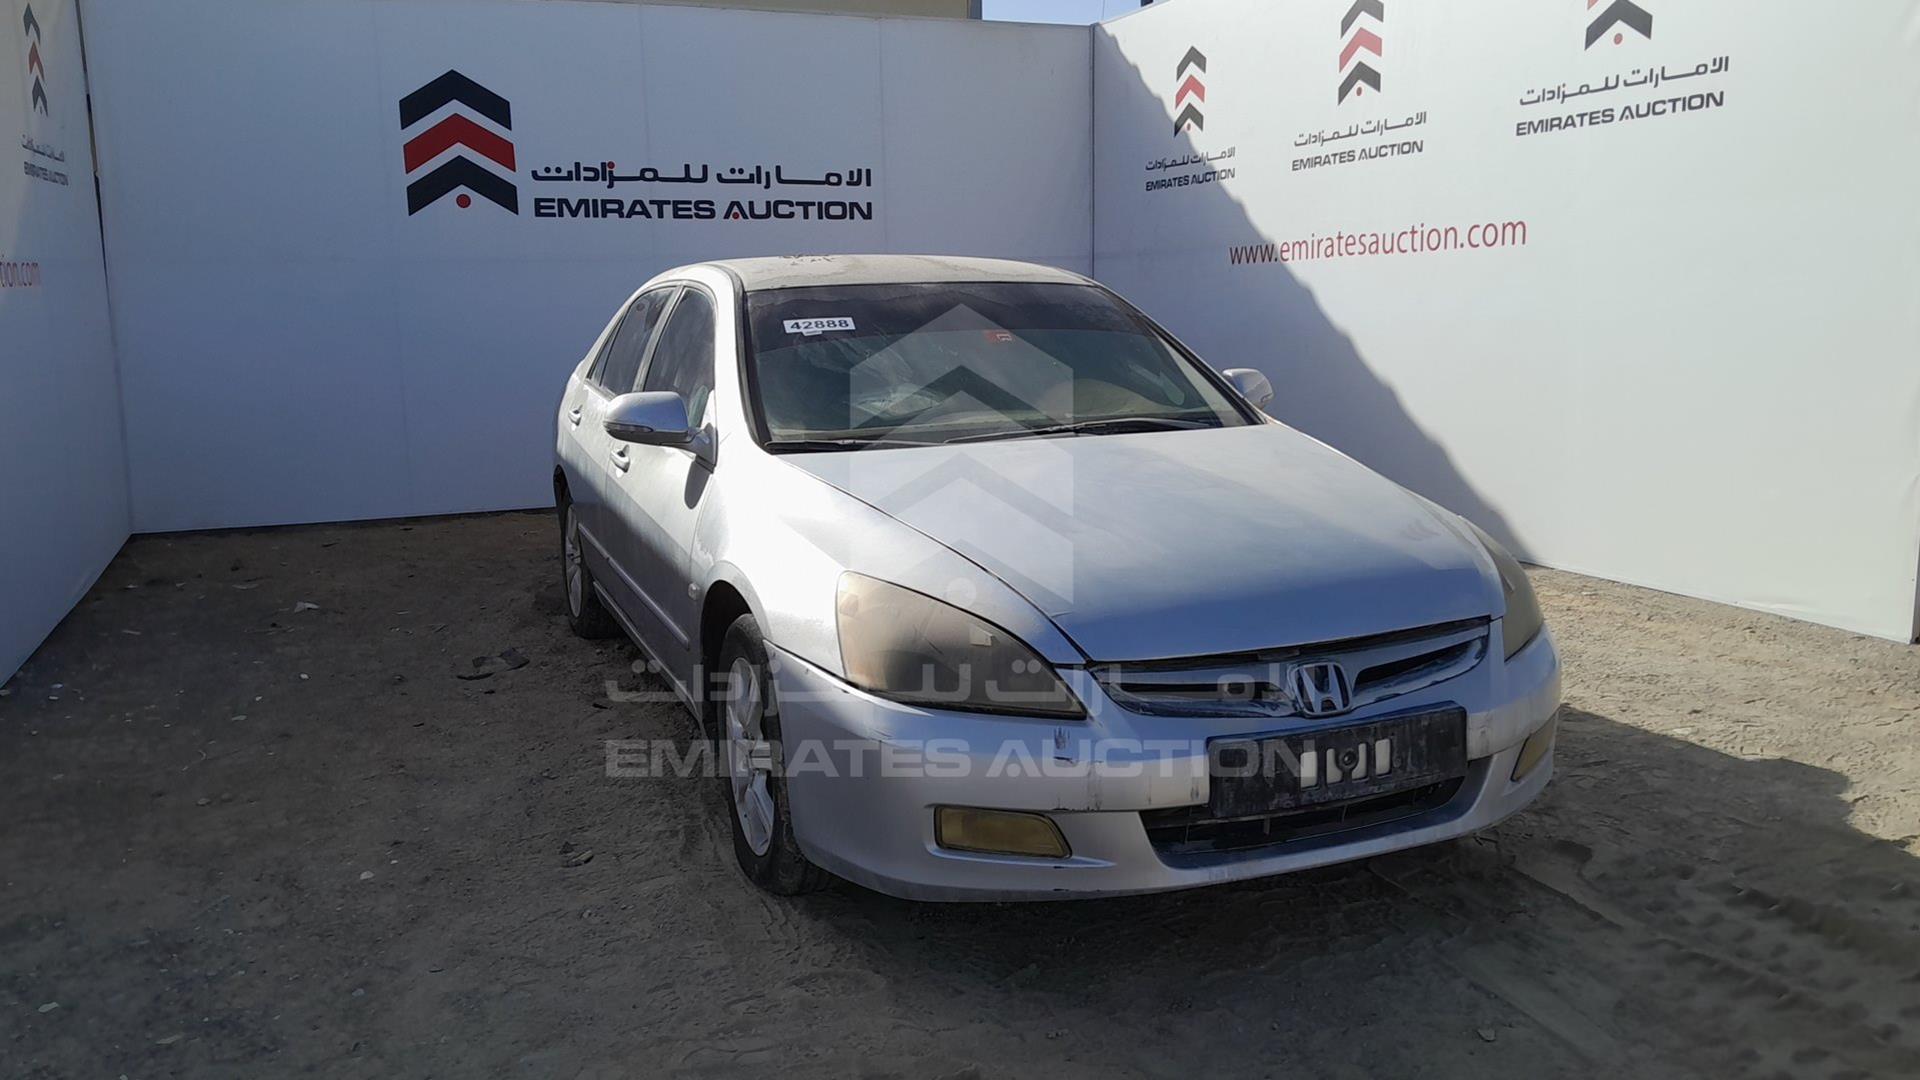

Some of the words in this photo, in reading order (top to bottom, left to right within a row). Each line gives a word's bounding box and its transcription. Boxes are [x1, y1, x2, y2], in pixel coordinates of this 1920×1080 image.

[1623, 56, 1730, 88] الامارات
[1519, 74, 1620, 106] للمزادات
[1515, 108, 1615, 137] EMIRATES
[1618, 90, 1725, 122] AUCTION
[1294, 126, 1359, 148] للمزادات
[1291, 149, 1356, 172] EMIRATES
[1357, 140, 1424, 162] AUCTION
[531, 160, 708, 189] للمزادات
[716, 165, 873, 190] الامارات
[1145, 175, 1190, 192] EMIRATES
[1190, 168, 1236, 185] AUCTION
[533, 197, 716, 220] EMIRATES
[723, 199, 873, 221] AUCTION
[1229, 220, 1527, 265] www.emiratesauction.com
[790, 319, 849, 330] 42888
